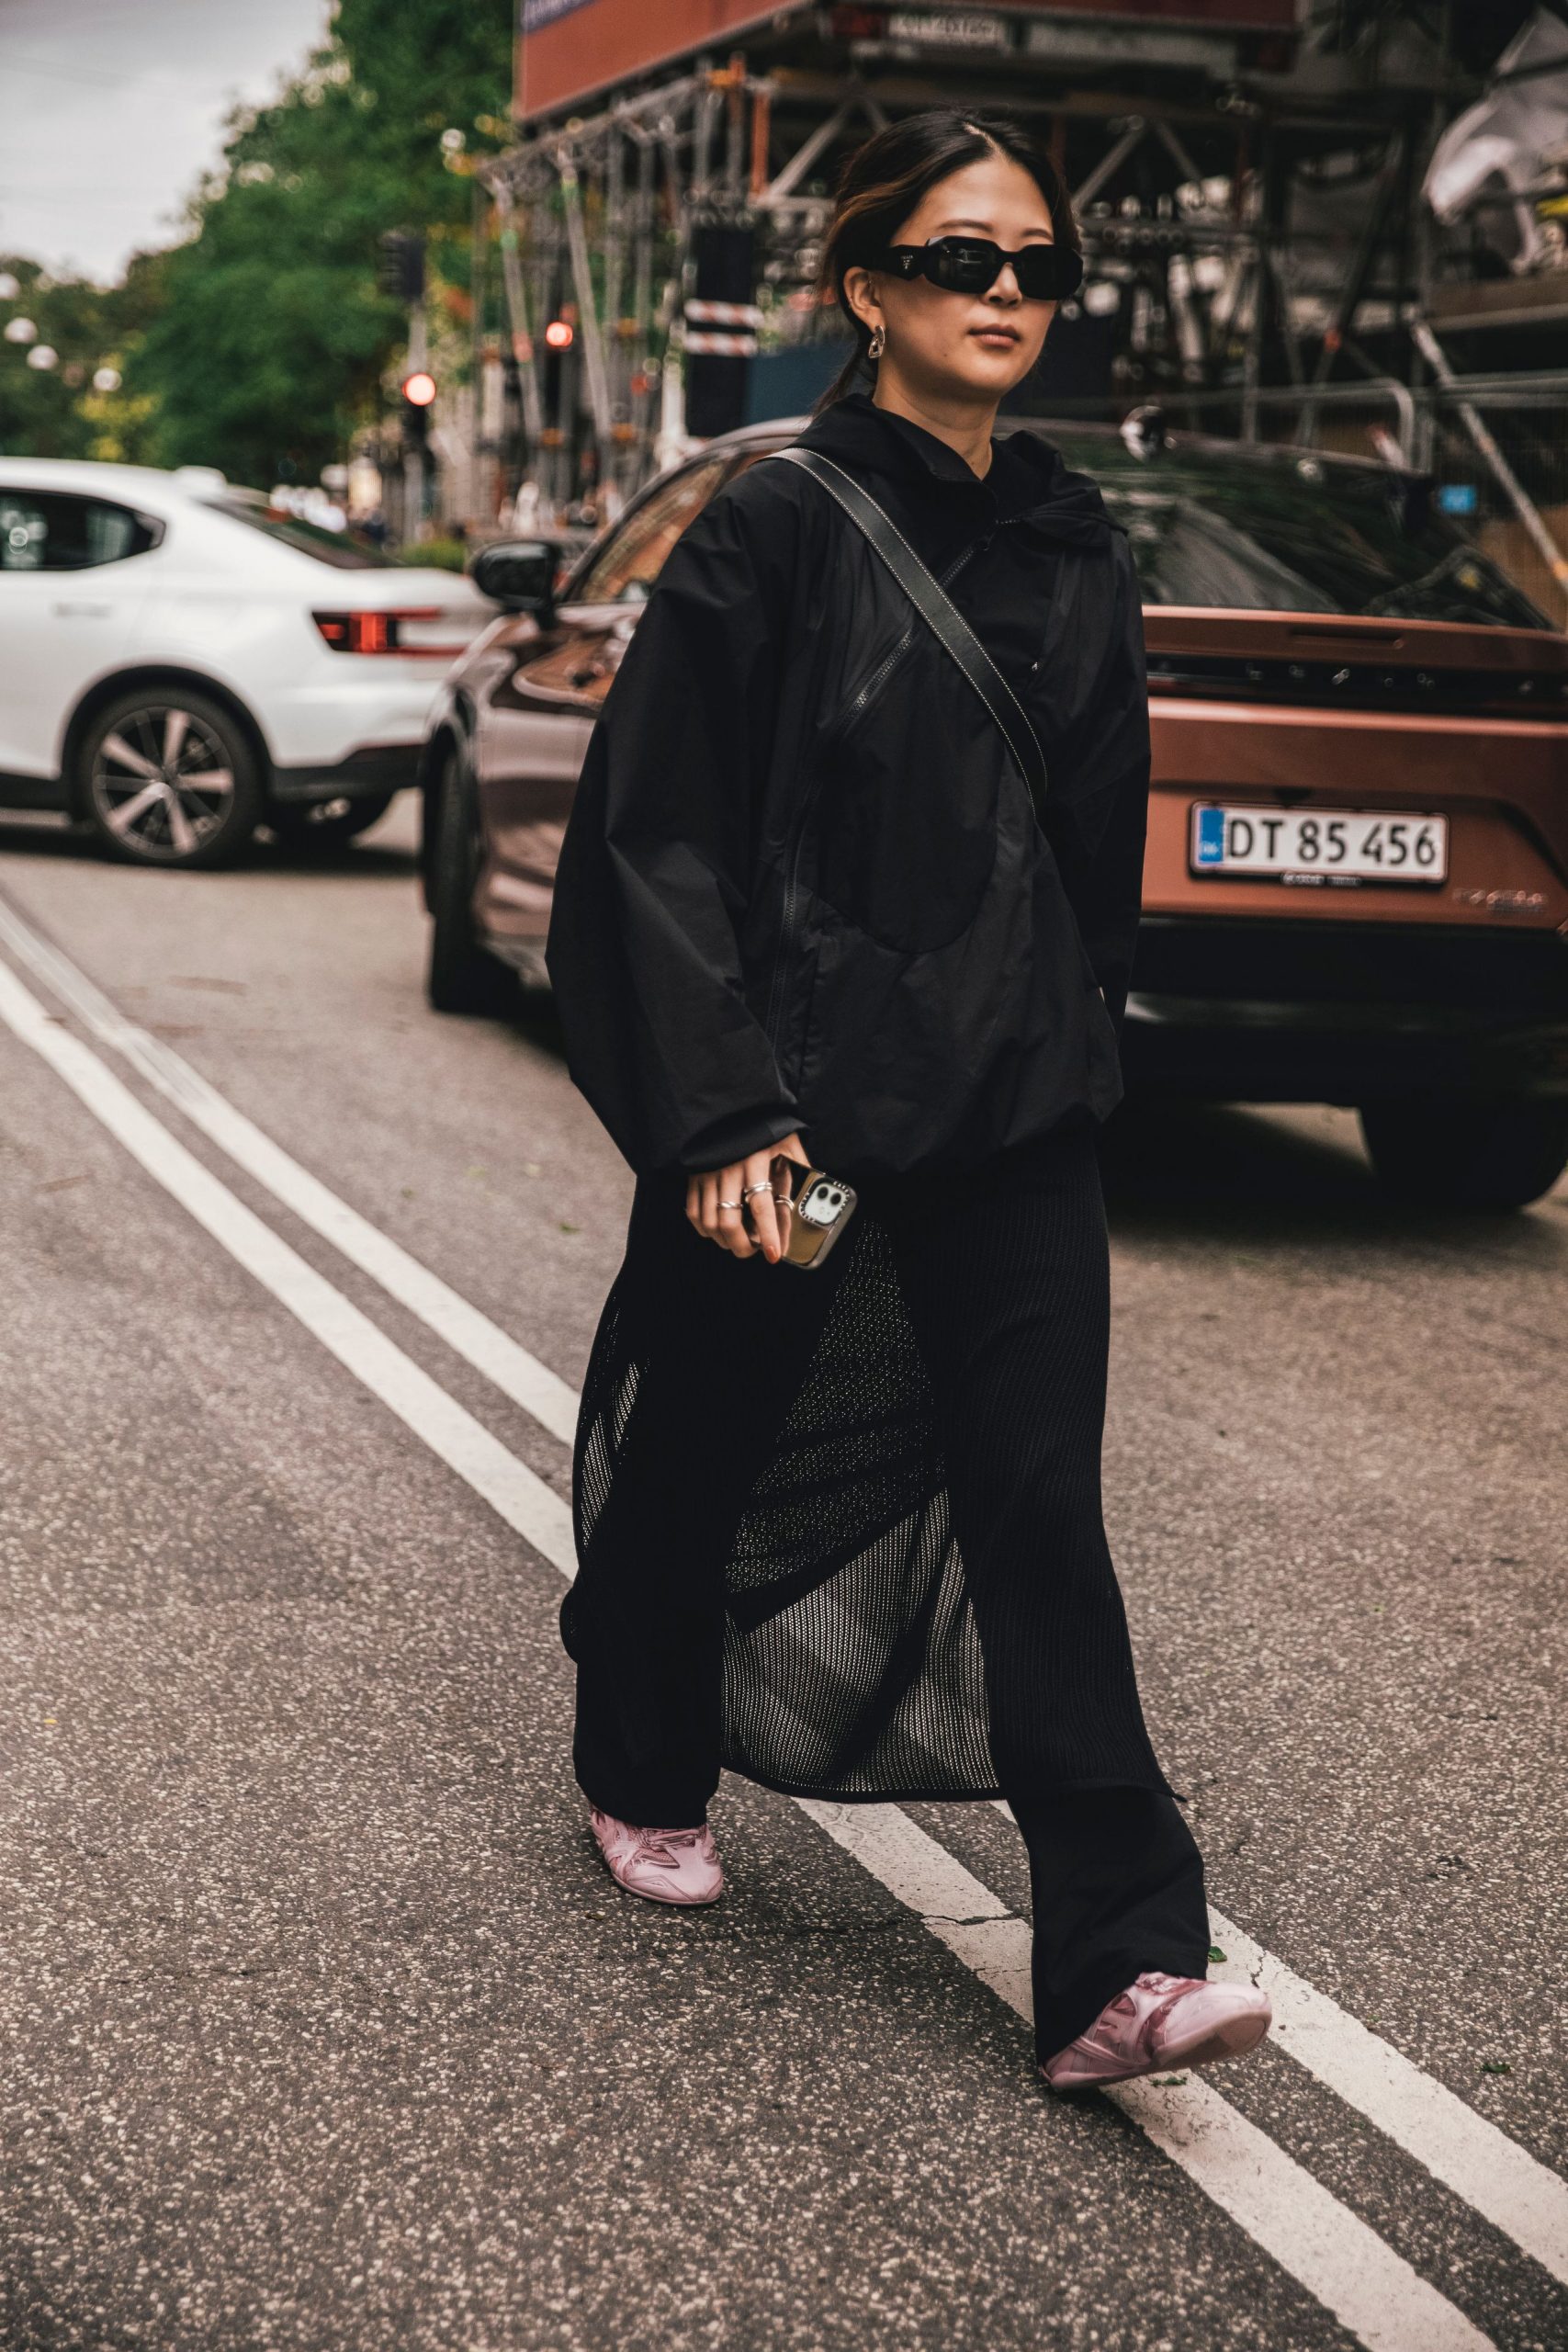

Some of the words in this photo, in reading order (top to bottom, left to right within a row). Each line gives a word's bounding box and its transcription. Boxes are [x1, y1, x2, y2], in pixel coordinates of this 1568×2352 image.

[1229, 819, 1283, 859] DT
[1298, 820, 1347, 863] 85
[1361, 822, 1436, 865] 456
